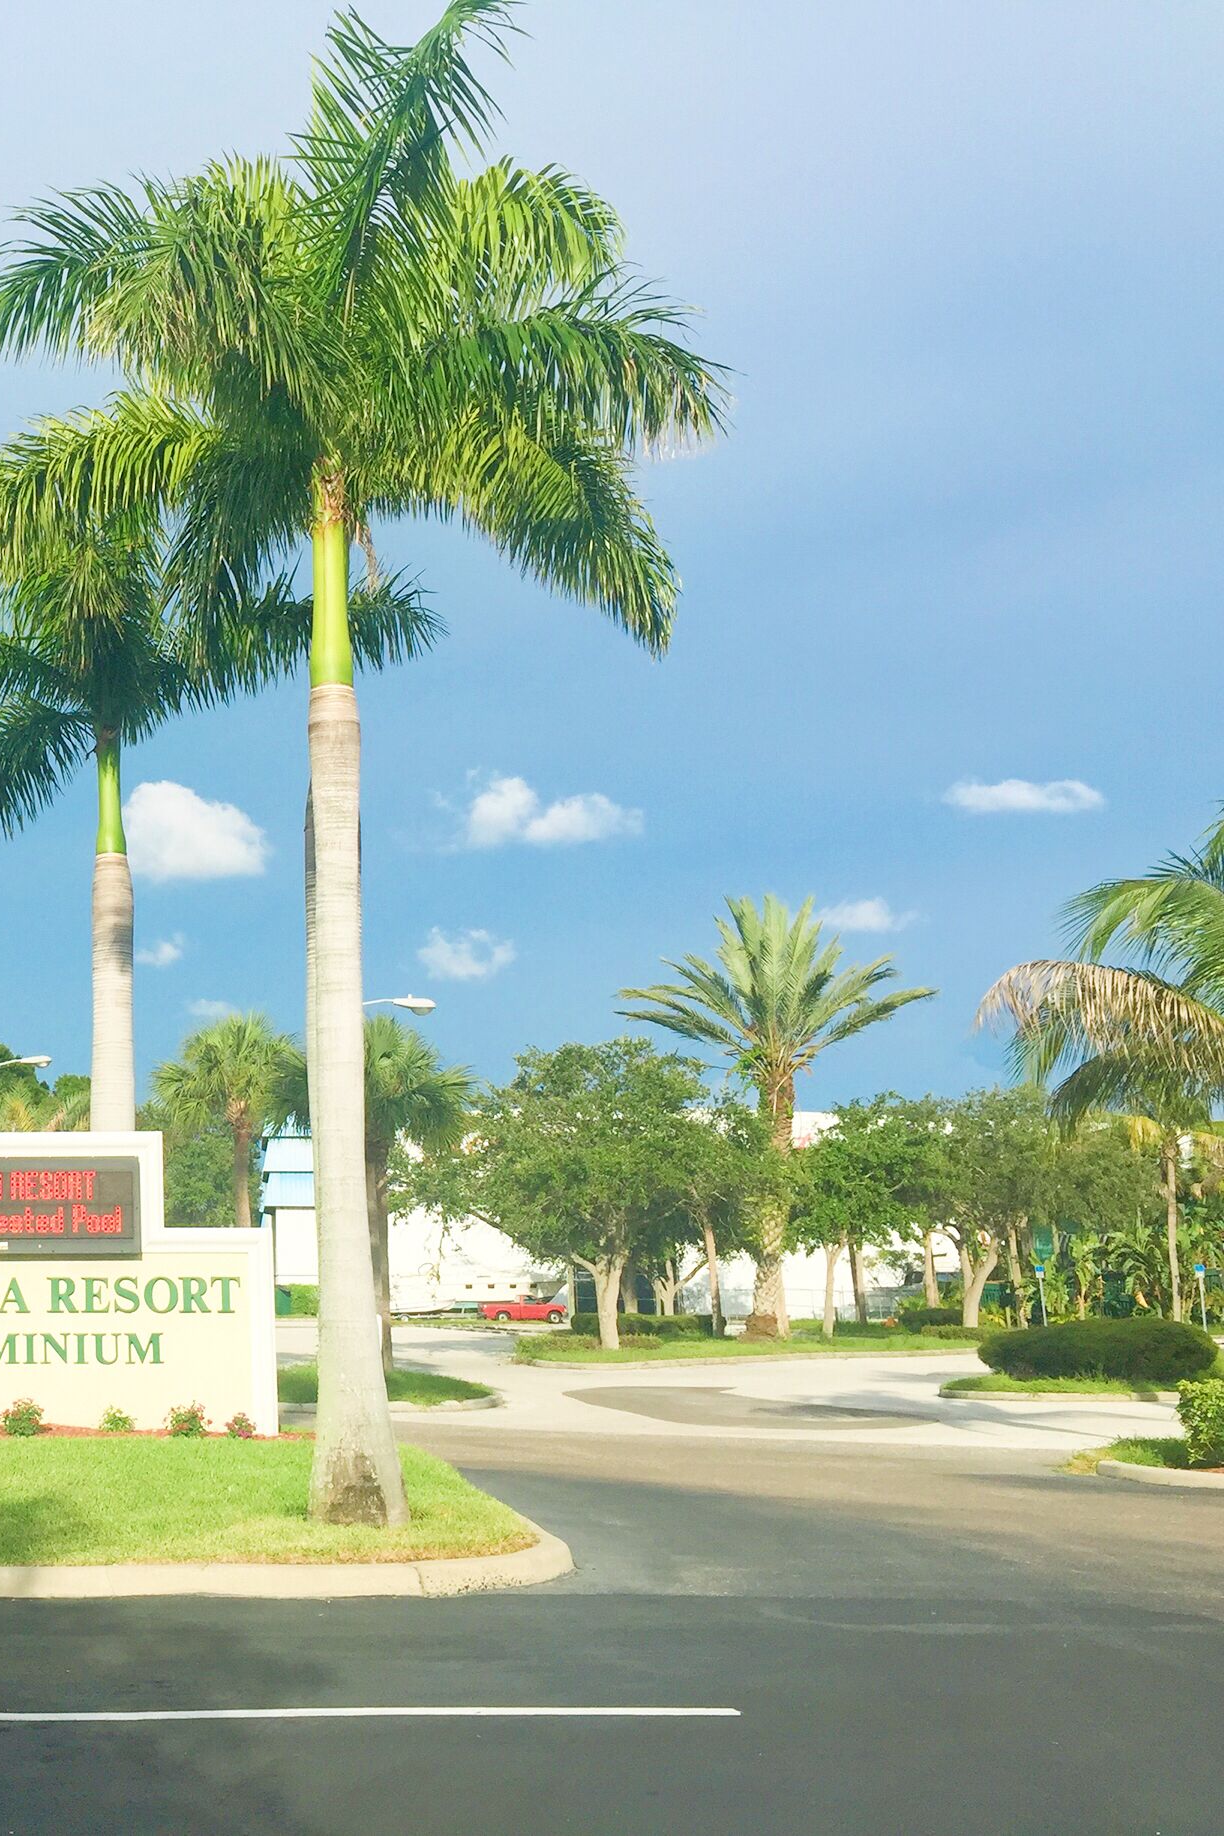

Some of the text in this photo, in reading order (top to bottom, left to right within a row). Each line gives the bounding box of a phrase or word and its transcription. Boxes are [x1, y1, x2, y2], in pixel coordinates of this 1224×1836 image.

[9, 1170, 97, 1201] RESORT
[71, 1203, 123, 1234] Pool
[46, 1276, 241, 1315] RESORT
